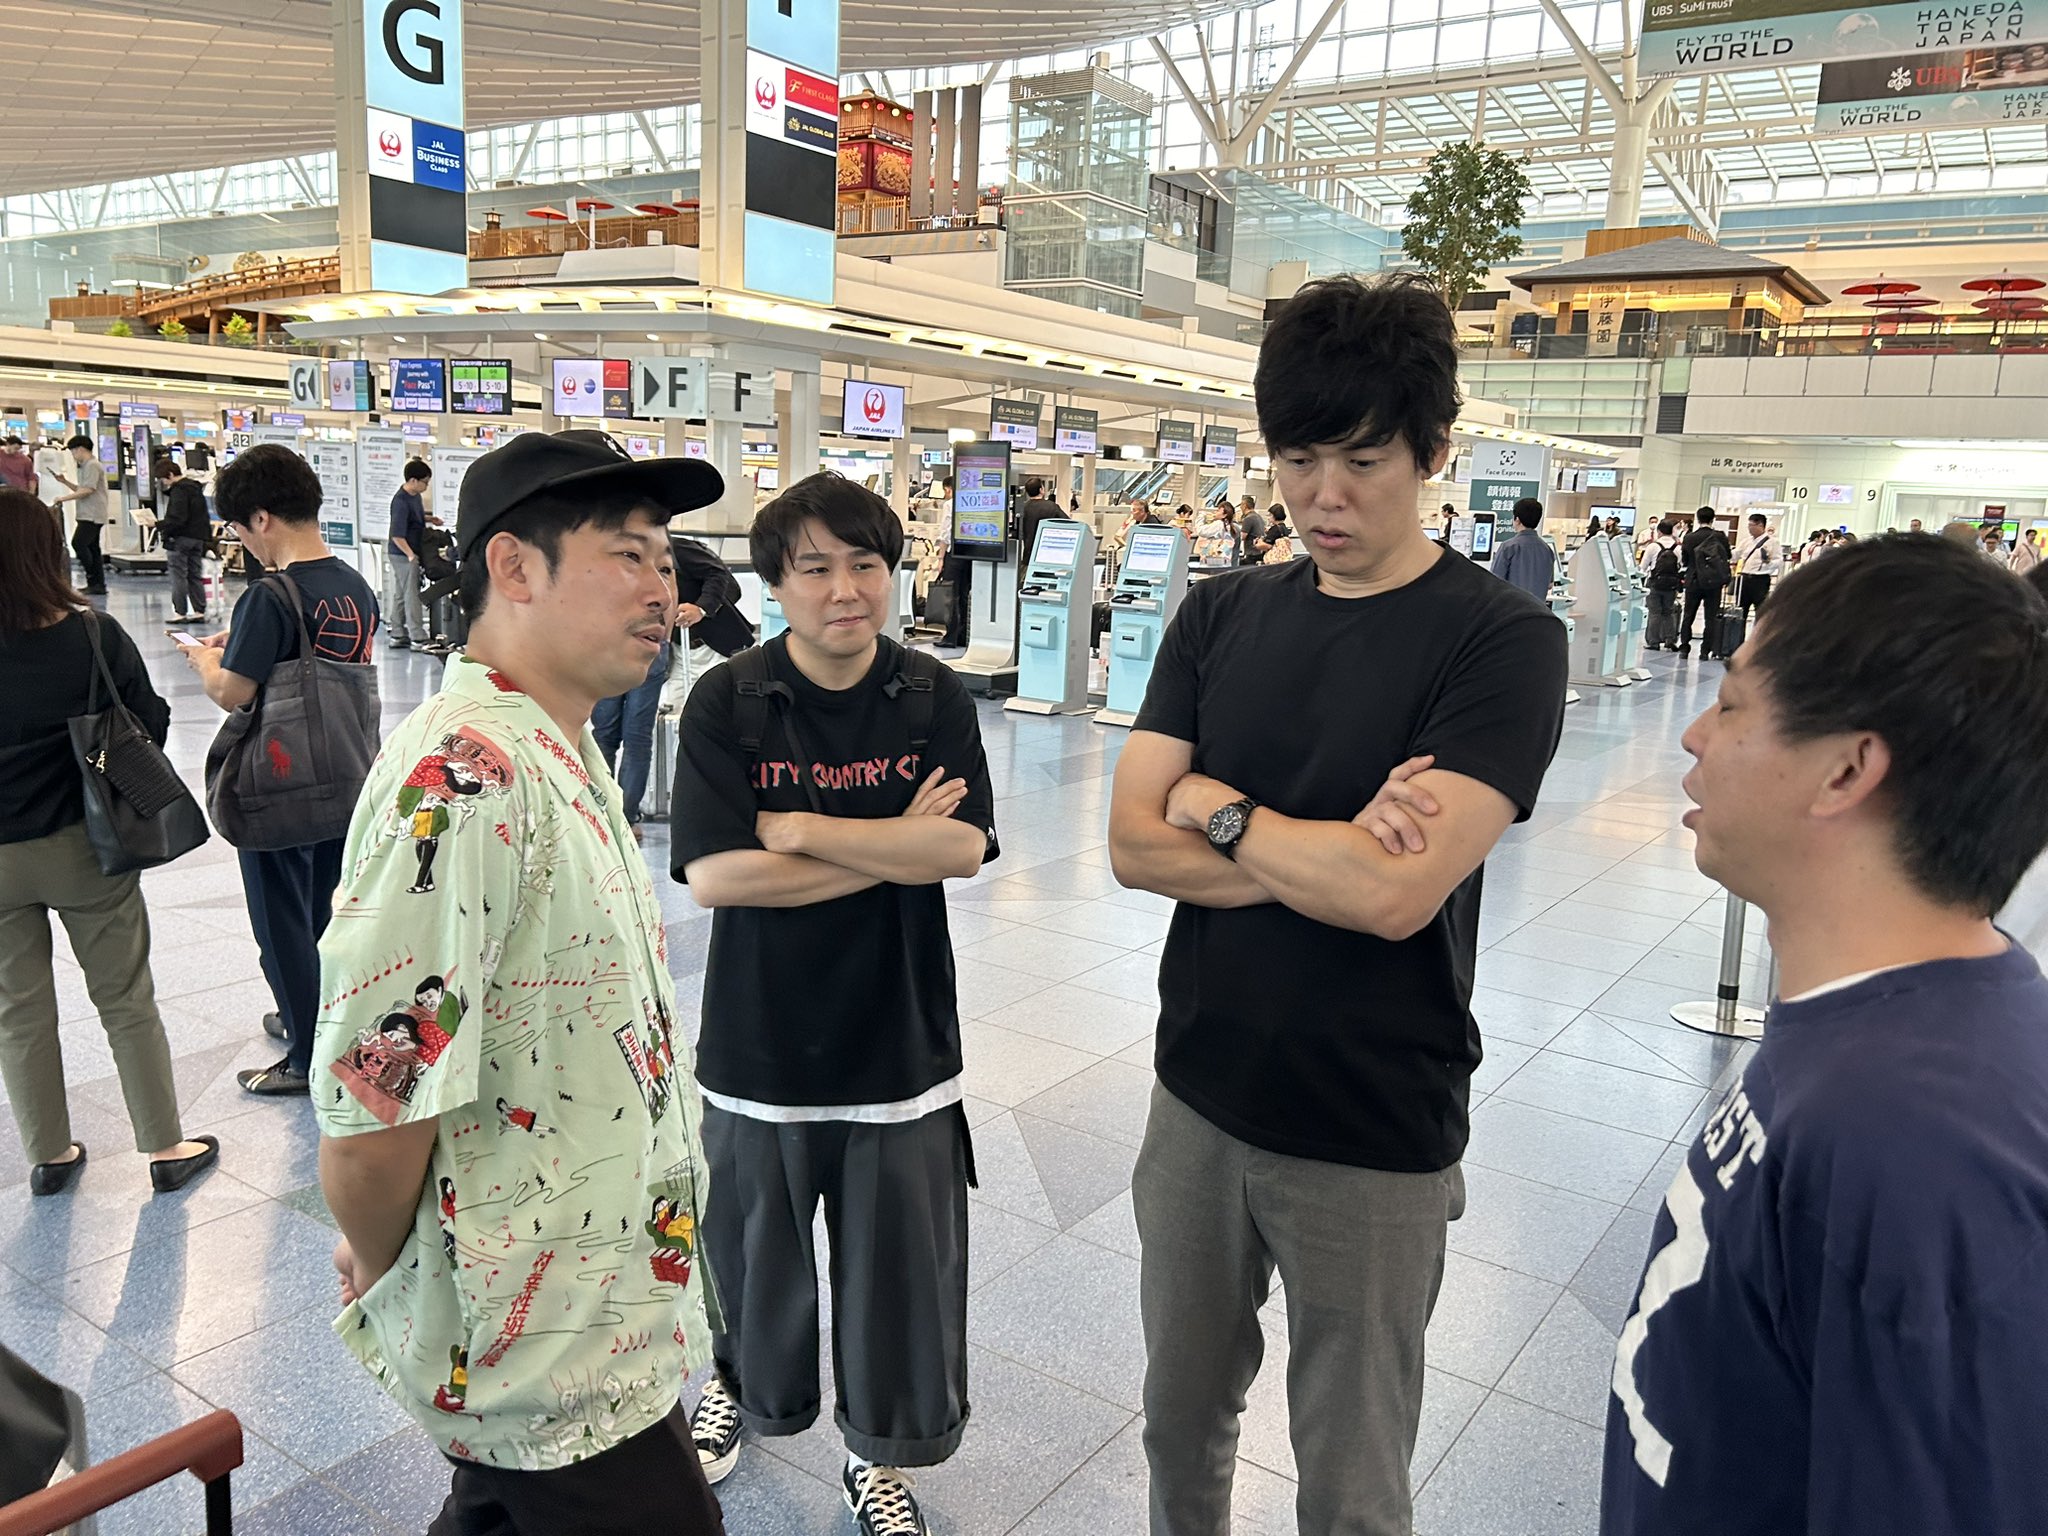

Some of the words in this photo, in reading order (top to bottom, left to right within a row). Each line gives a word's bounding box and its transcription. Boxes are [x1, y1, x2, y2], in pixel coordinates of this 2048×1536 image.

[1651, 4, 1674, 17] UBS
[1706, 0, 1734, 10] TRUST
[1917, 1, 2024, 22] HANEDA
[1916, 14, 2023, 35] TOKYO
[383, 0, 444, 85] G
[1676, 35, 1706, 48] FLY
[1711, 32, 1733, 43] TO
[1740, 28, 1774, 41] THE
[1915, 27, 2022, 48] JAPAN
[1676, 37, 1794, 65] WORLD
[1915, 66, 1962, 87] UBS
[1840, 106, 1862, 115] FLY
[1866, 105, 1880, 113] TO
[1885, 103, 1908, 112] THE
[2003, 108, 2048, 119] JAP
[2004, 100, 2043, 110] TOK
[1840, 109, 1922, 127] WORLD
[431, 140, 446, 150] JAL
[1596, 294, 1616, 343] 伊藤園
[293, 367, 306, 401] G
[668, 367, 687, 407] F
[735, 371, 751, 412] F
[868, 412, 881, 420] JAL
[77, 421, 85, 436] 1
[241, 434, 249, 446] 2
[1735, 459, 1784, 469] Departures
[1501, 469, 1526, 477] Express
[1486, 485, 1522, 498] 顔情報
[1791, 487, 1808, 499] 10
[1867, 489, 1876, 501] 9
